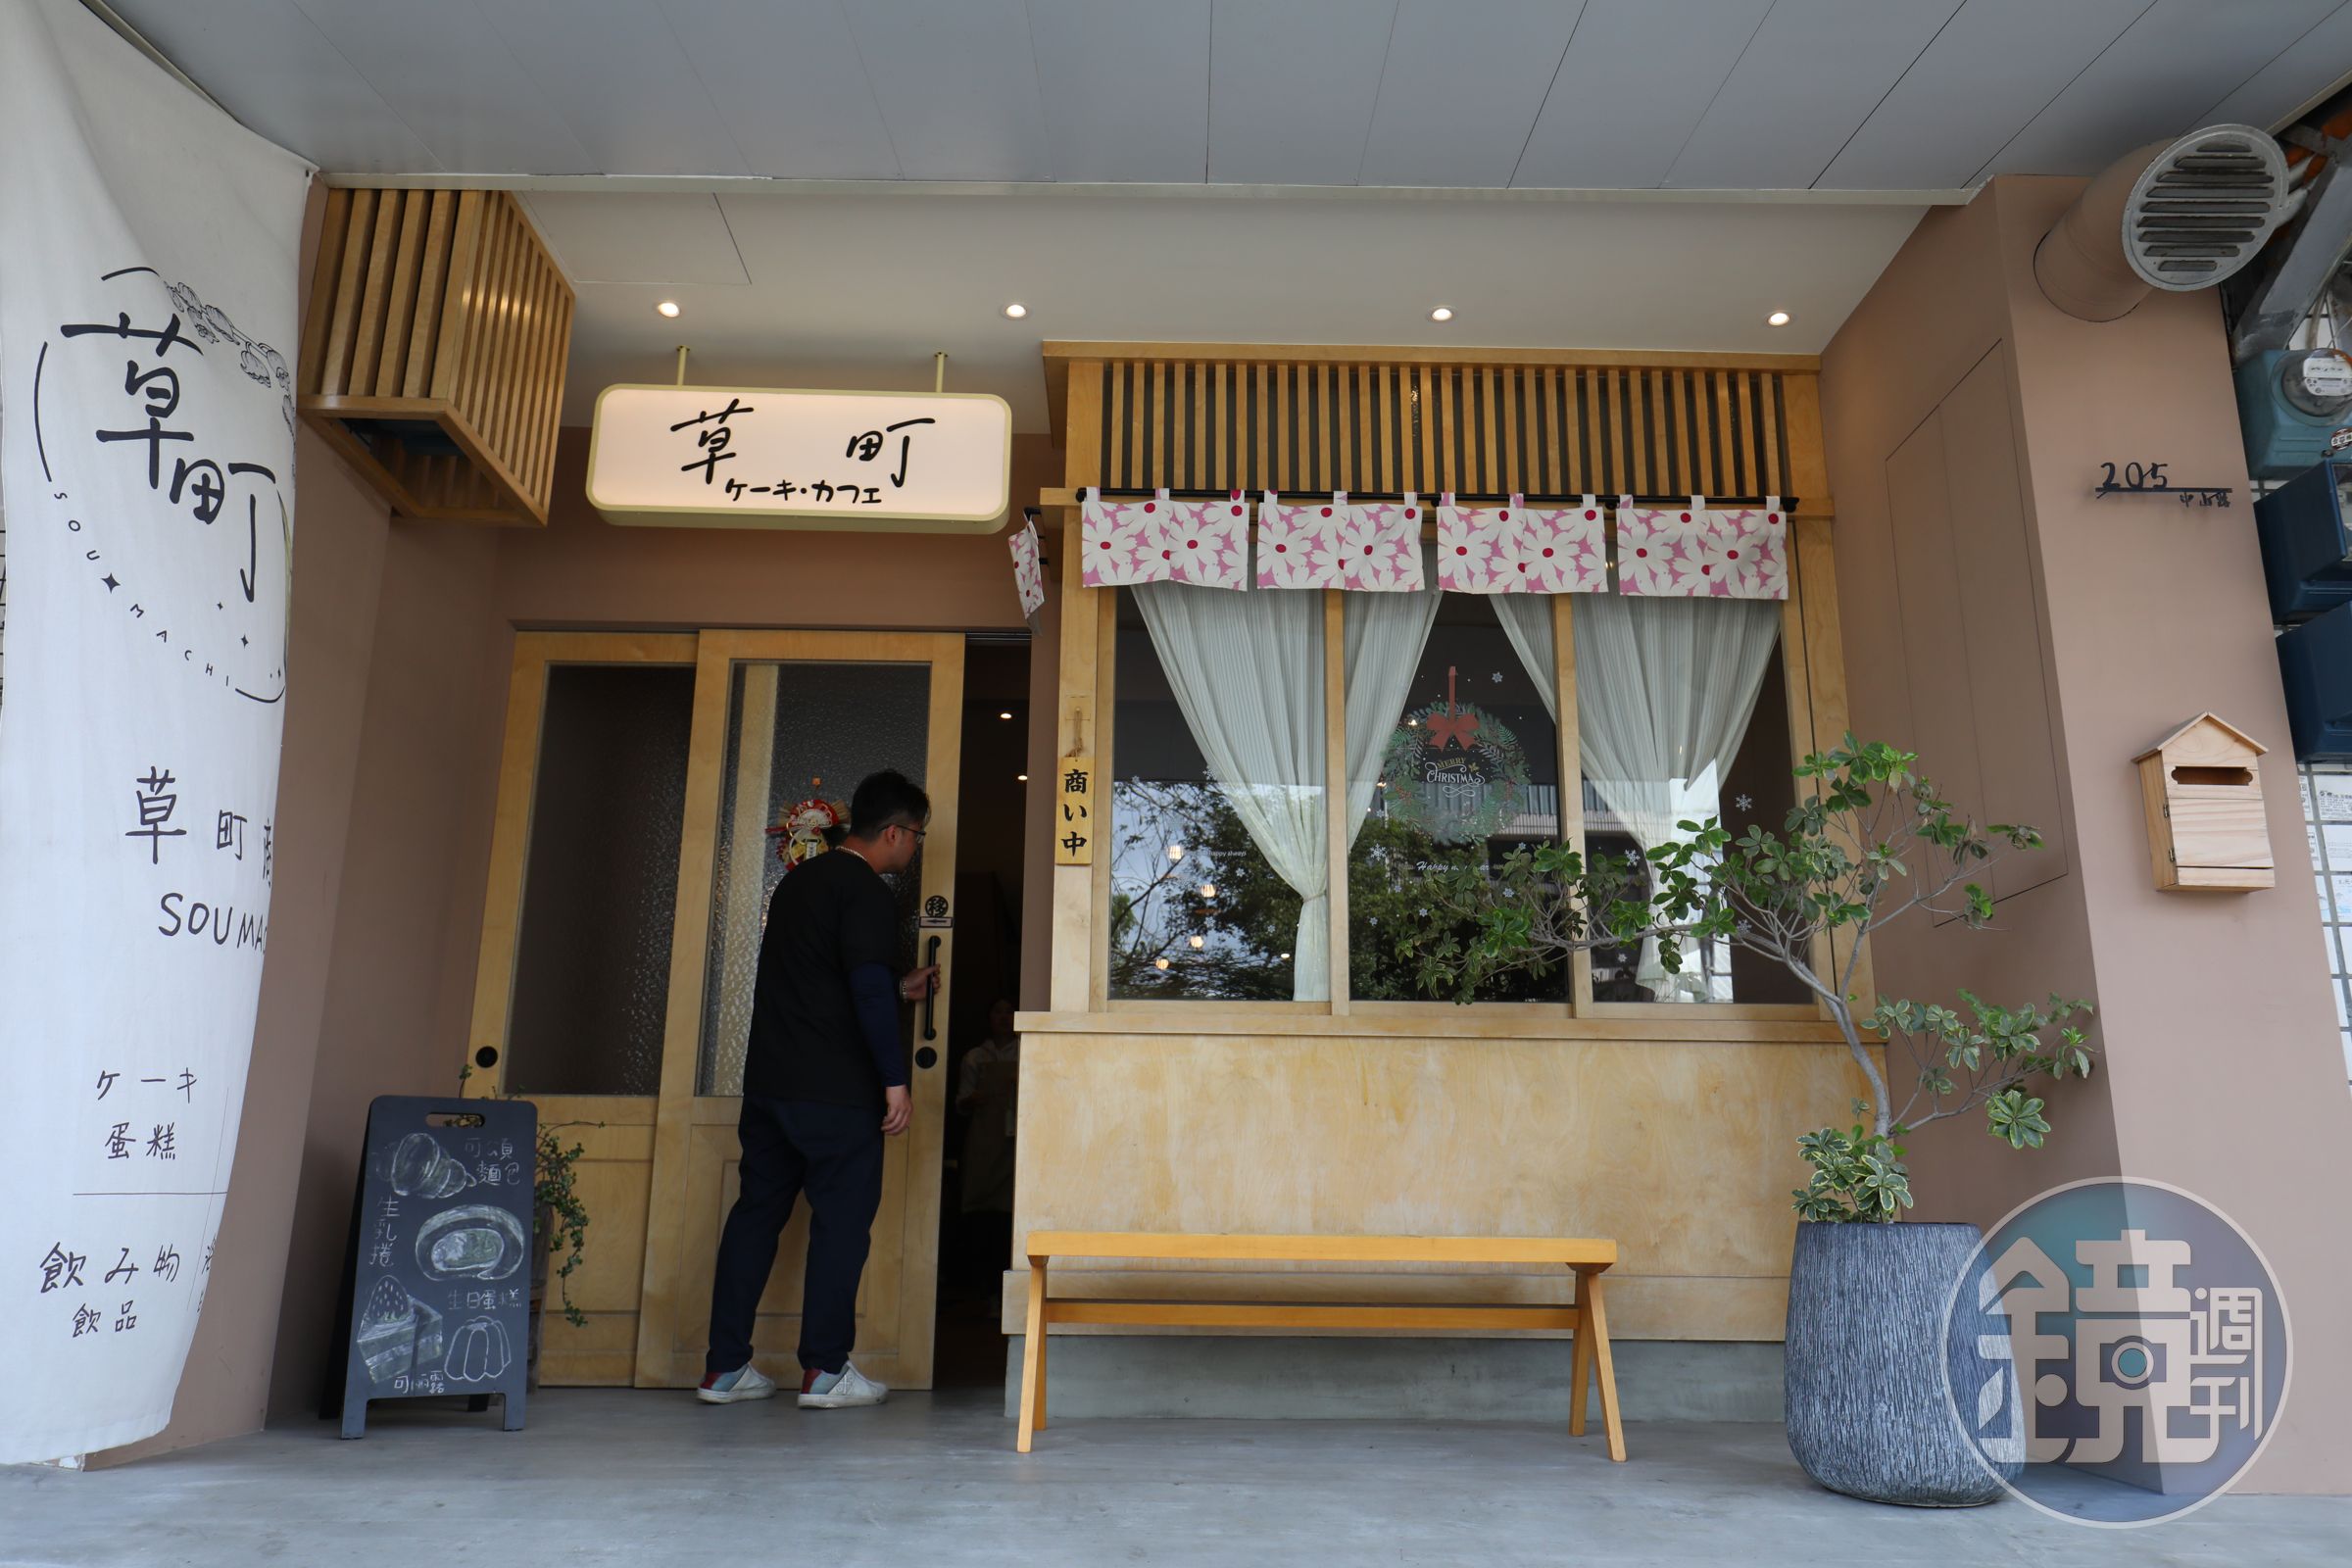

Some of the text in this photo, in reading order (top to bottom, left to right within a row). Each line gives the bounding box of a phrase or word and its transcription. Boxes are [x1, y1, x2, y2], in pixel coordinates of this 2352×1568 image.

[61, 312, 276, 604] 草町
[670, 399, 936, 487] 草町
[725, 478, 882, 504] ケーキ・カフェ
[2100, 462, 2168, 488] 205
[2180, 492, 2230, 508] 中山路
[53, 492, 229, 686] SOU MACHI
[1426, 765, 1486, 786] CHRISTMAS
[1437, 757, 1466, 769] MERRY
[1061, 768, 1089, 857] 商い中
[1416, 861, 1448, 872] Happy
[96, 1066, 198, 1104] ケーキ
[104, 1121, 176, 1160] 蛋糕
[40, 1241, 180, 1294] 飲み物
[72, 1298, 137, 1338] 飲品
